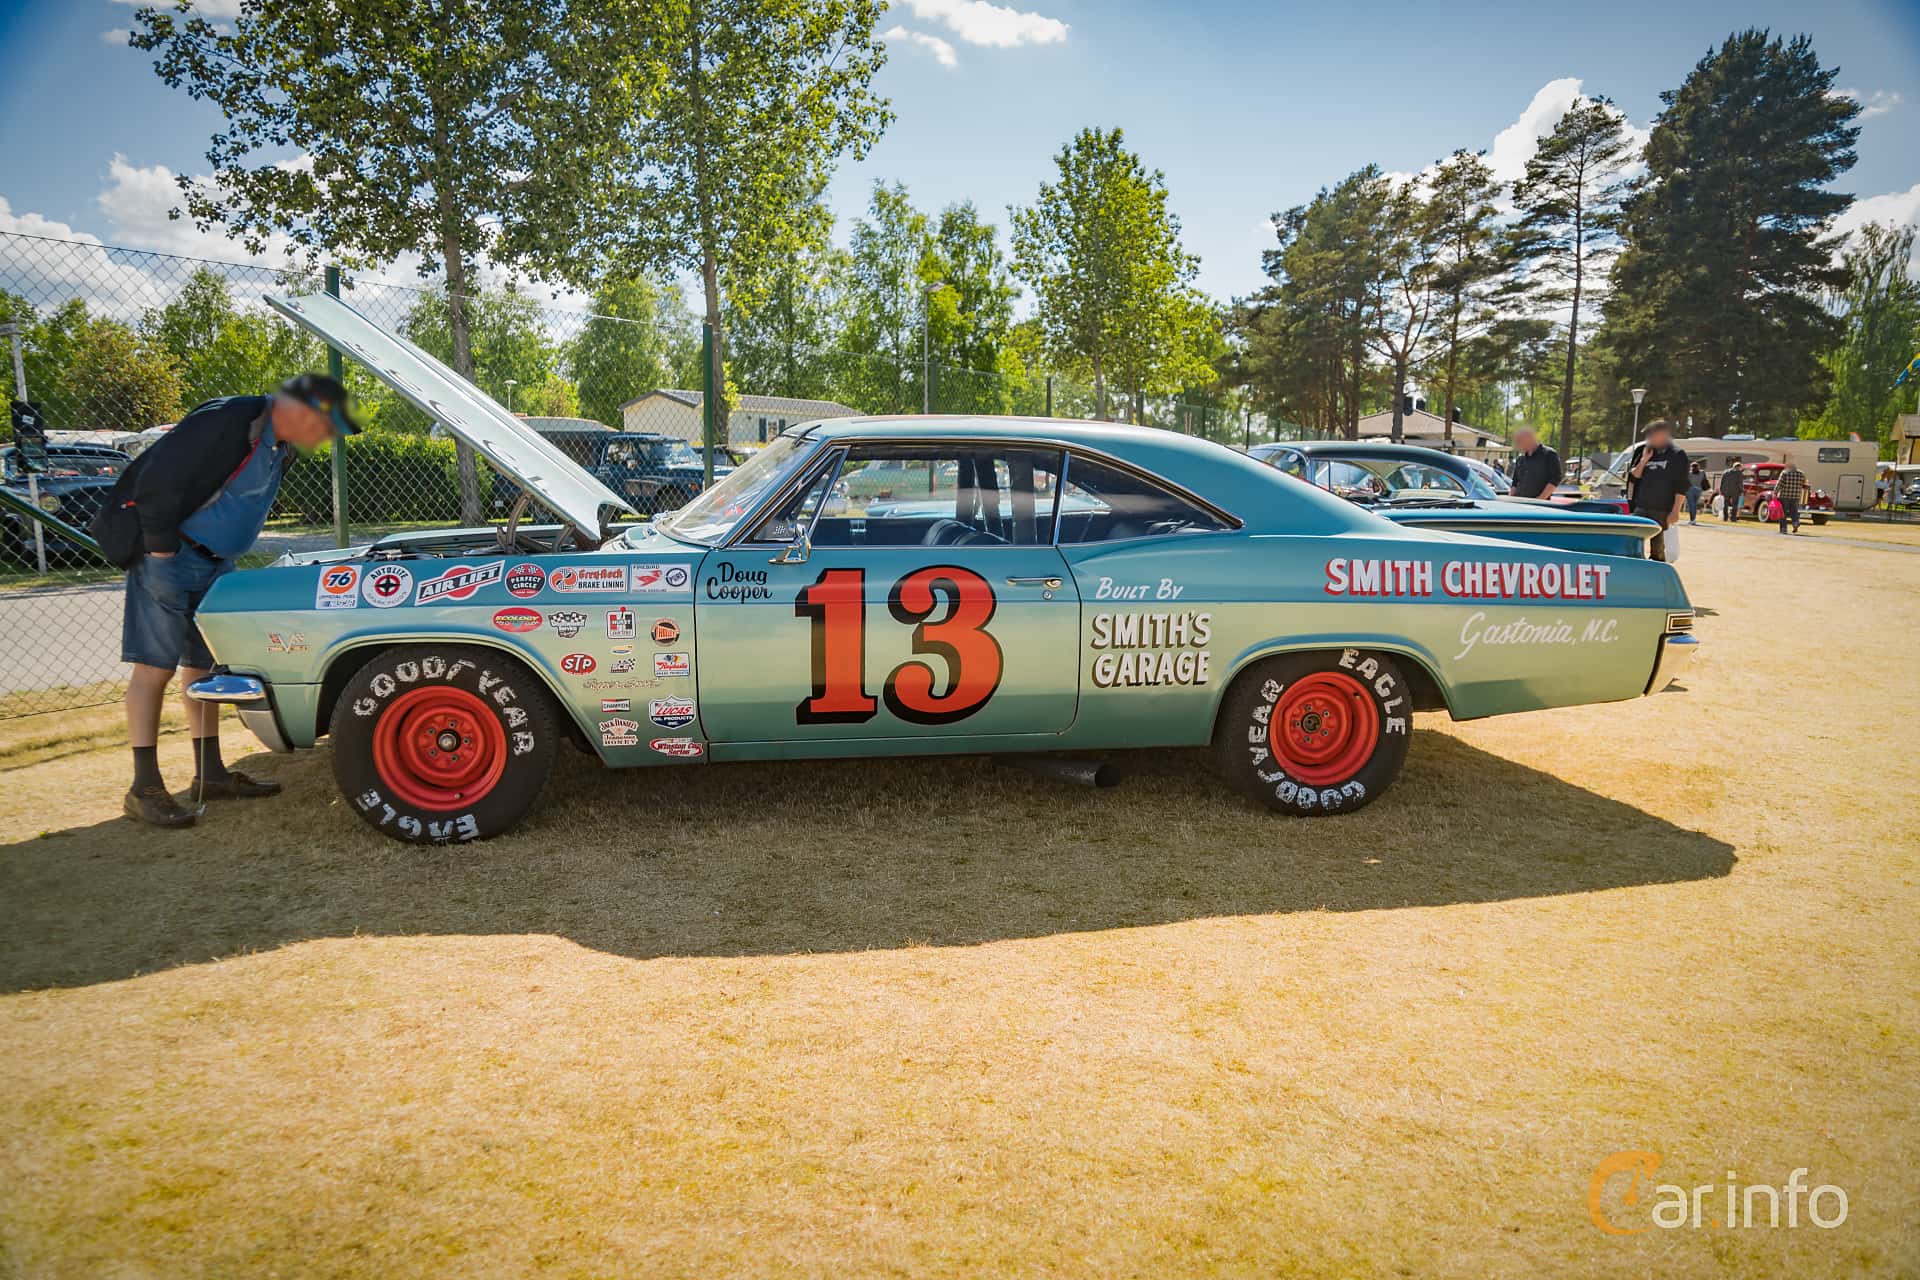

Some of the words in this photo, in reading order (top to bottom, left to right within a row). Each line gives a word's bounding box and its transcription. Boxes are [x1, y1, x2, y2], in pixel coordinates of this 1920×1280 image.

[327, 571, 352, 587] 76
[370, 567, 409, 580] AUTOLITE
[422, 577, 456, 598] AIR
[458, 566, 499, 588] LIFT
[510, 576, 542, 584] PERFECT
[578, 581, 600, 589] BRAKE
[602, 581, 624, 589] LINING
[717, 562, 768, 585] Doug
[1325, 558, 1433, 597] SMITH
[1441, 561, 1611, 599] CHEVROLET
[706, 577, 772, 604] Cooper
[1091, 612, 1212, 649] SMITH'S
[1453, 612, 1577, 661] Gastonia,
[1581, 618, 1620, 643] N.C.
[795, 564, 1004, 725] 13
[565, 654, 592, 673] STP
[1092, 651, 1211, 688] GARAGE
[1339, 648, 1407, 735] EAGLE
[656, 707, 692, 715] LUCAS
